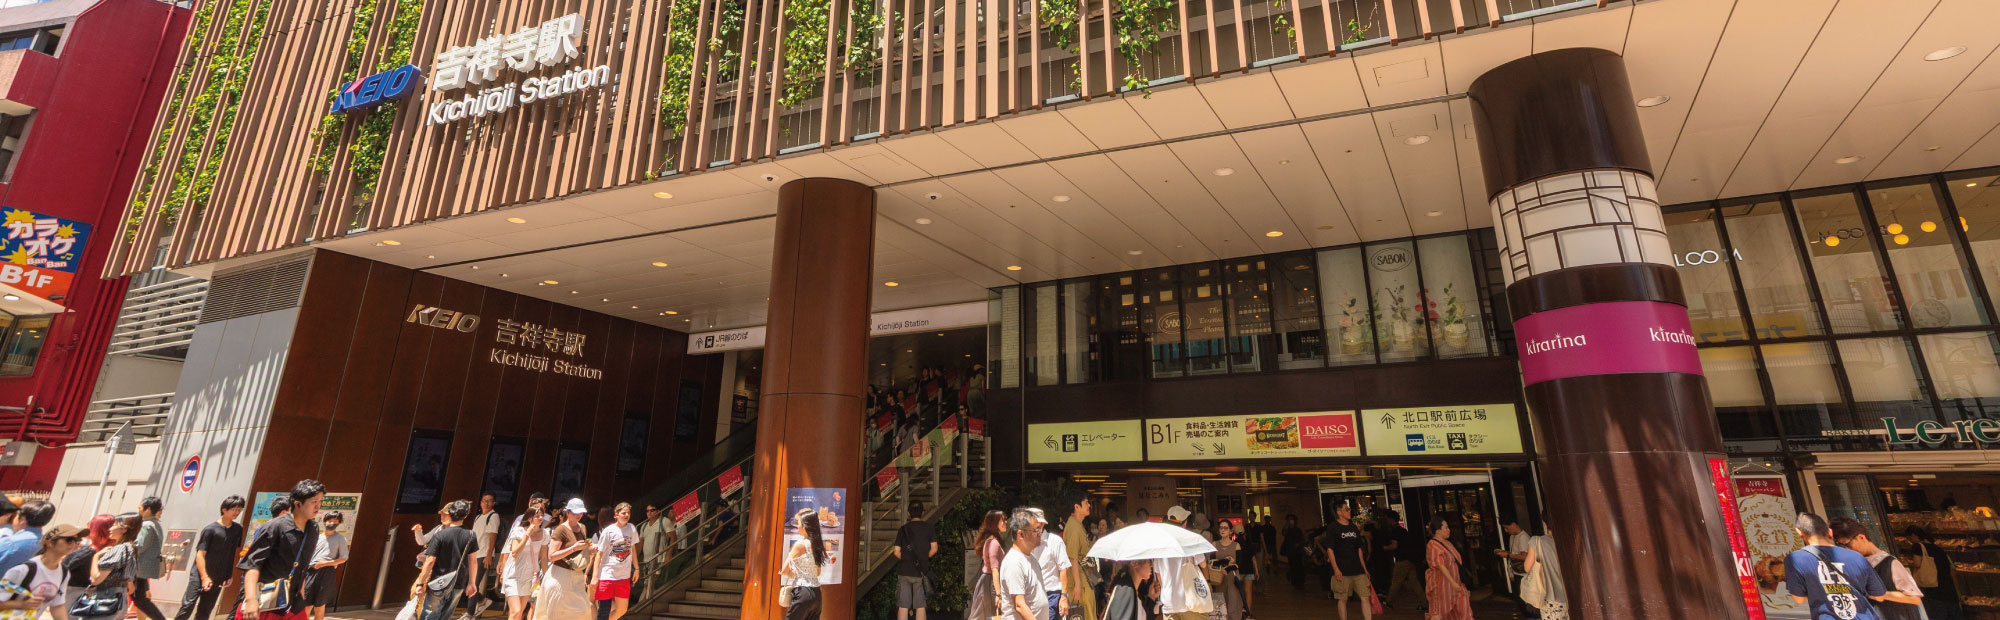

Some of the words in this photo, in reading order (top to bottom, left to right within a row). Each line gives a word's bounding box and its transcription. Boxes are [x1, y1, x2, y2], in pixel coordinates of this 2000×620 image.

[433, 13, 583, 91] 吉祥寺駅
[331, 64, 420, 114] KEIO
[520, 65, 610, 103] Station
[1377, 252, 1406, 266] SABON
[0, 264, 54, 288] B1F
[407, 304, 480, 333] KEIO
[904, 319, 930, 328] Station
[496, 318, 587, 357] 吉祥寺駅
[1526, 332, 1587, 356] kirarina
[553, 359, 603, 380] Station
[1402, 408, 1487, 423] 北口駅前広場
[1081, 432, 1126, 442] エレベーター
[1151, 423, 1182, 444] B1F
[1185, 430, 1229, 439] 売場のご案内
[1305, 424, 1348, 436] DAISO
[1826, 429, 1872, 437] BAKERY
[1880, 416, 1947, 444] Le
[1952, 419, 2000, 443] re
[1754, 529, 1789, 545] 金賞
